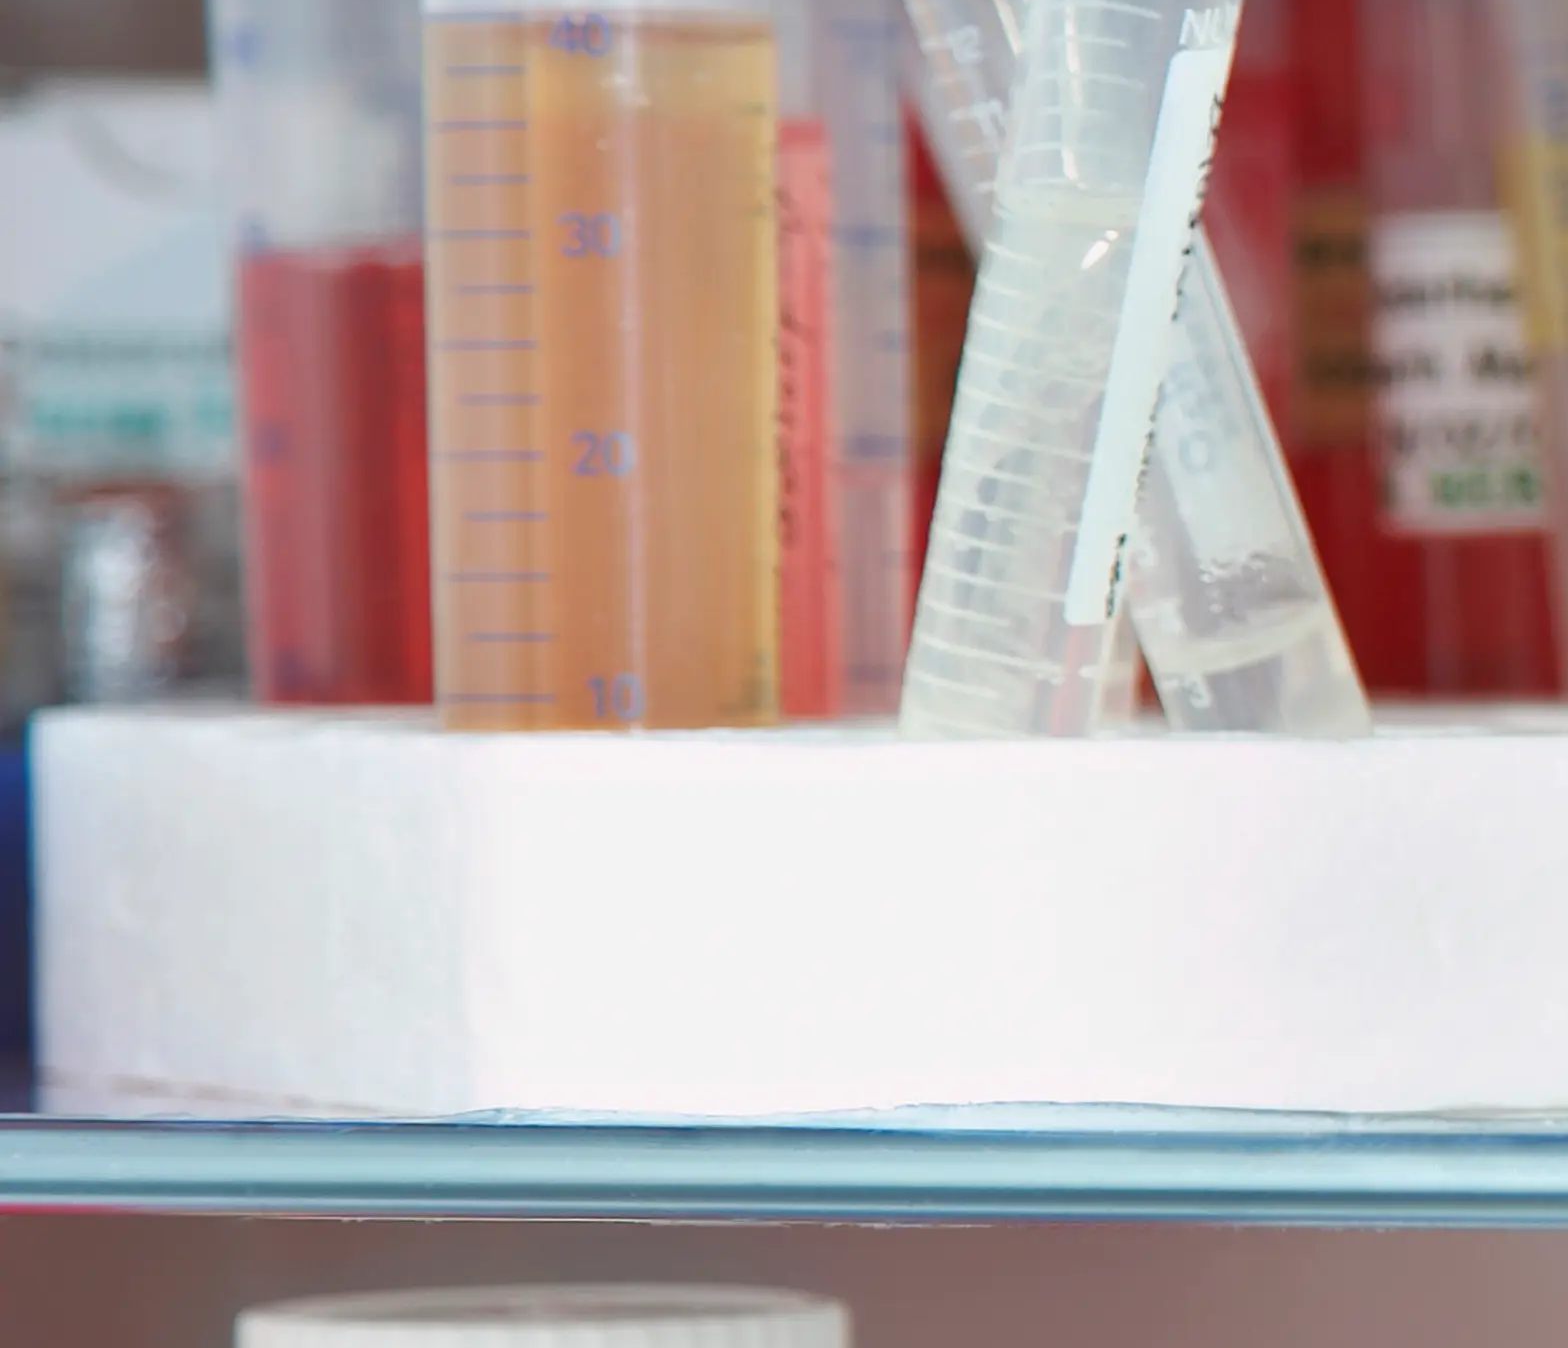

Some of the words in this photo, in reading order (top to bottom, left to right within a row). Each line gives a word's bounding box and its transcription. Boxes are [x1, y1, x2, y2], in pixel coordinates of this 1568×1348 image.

[547, 10, 613, 57] 40
[555, 211, 622, 258] 30
[569, 430, 637, 479] 20
[587, 672, 647, 723] 10
